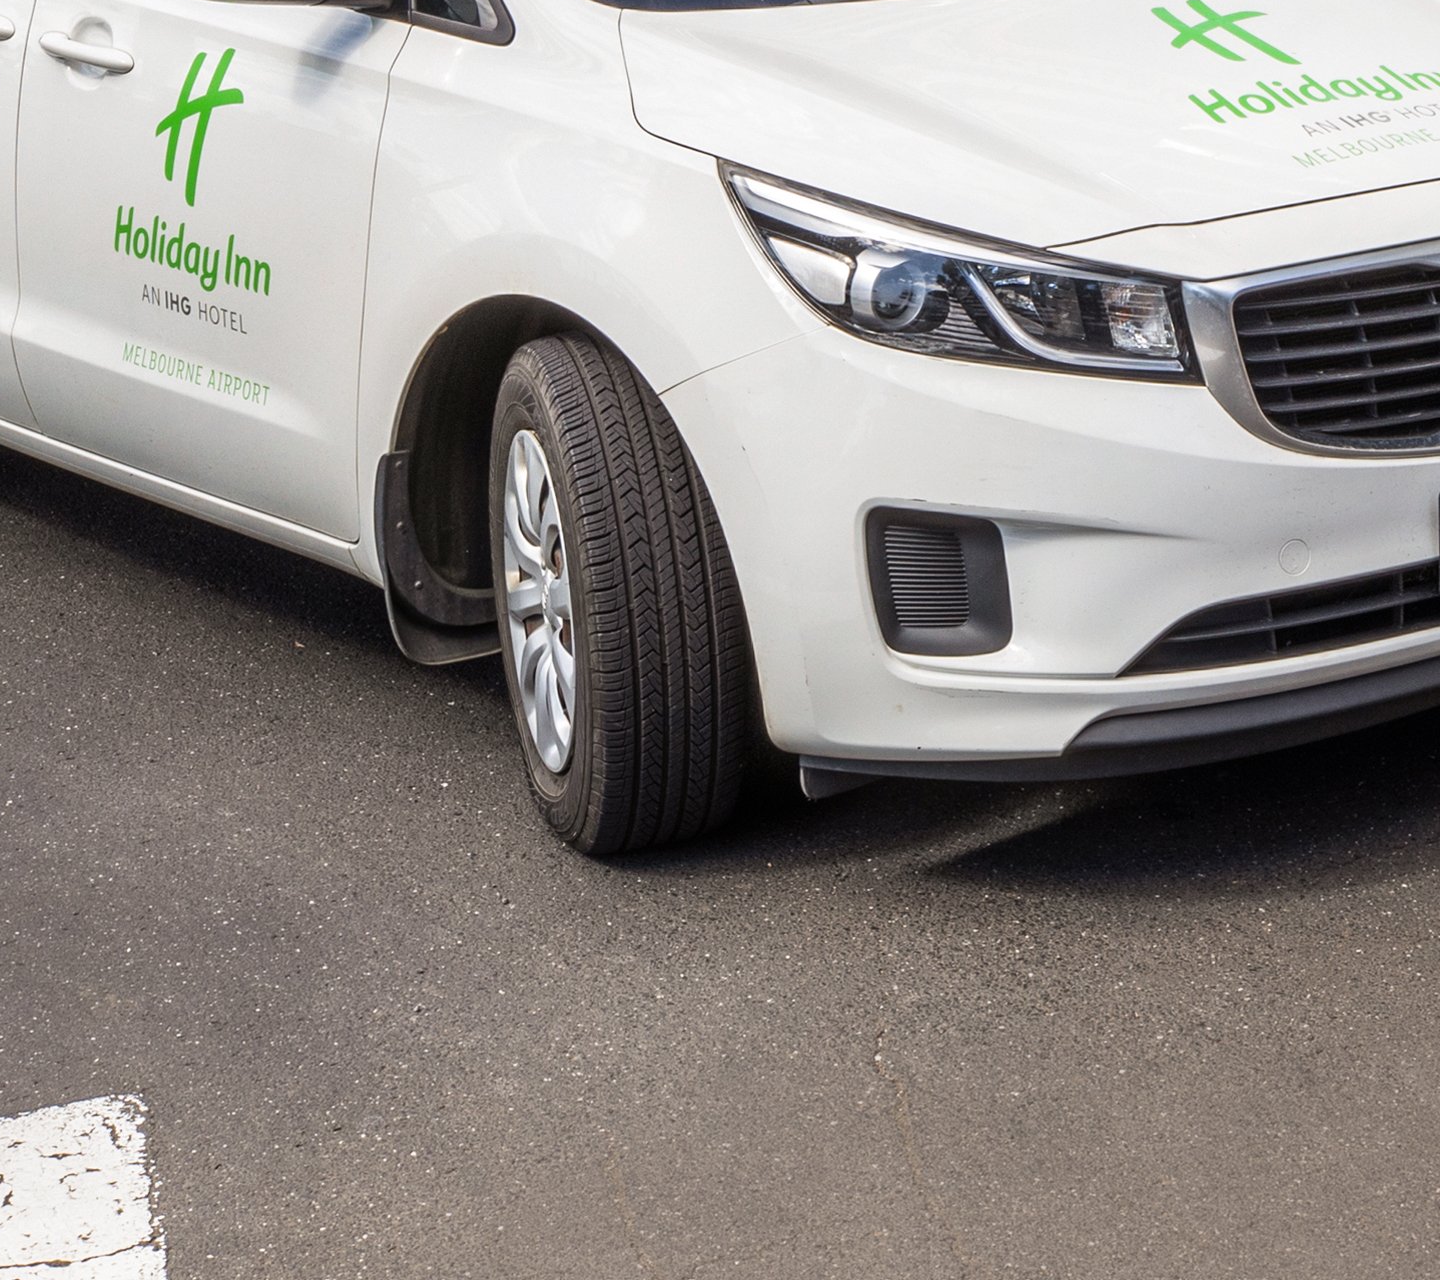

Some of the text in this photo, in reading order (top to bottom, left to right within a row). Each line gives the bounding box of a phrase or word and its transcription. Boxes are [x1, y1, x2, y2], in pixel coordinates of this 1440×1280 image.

[1188, 65, 1404, 124] Holiday
[1301, 119, 1341, 137] AN
[114, 205, 271, 297] Holiday Inn
[142, 283, 161, 307] AN
[198, 301, 248, 335] HOTEL
[122, 341, 271, 406] MELBOURNE AIRPORT
